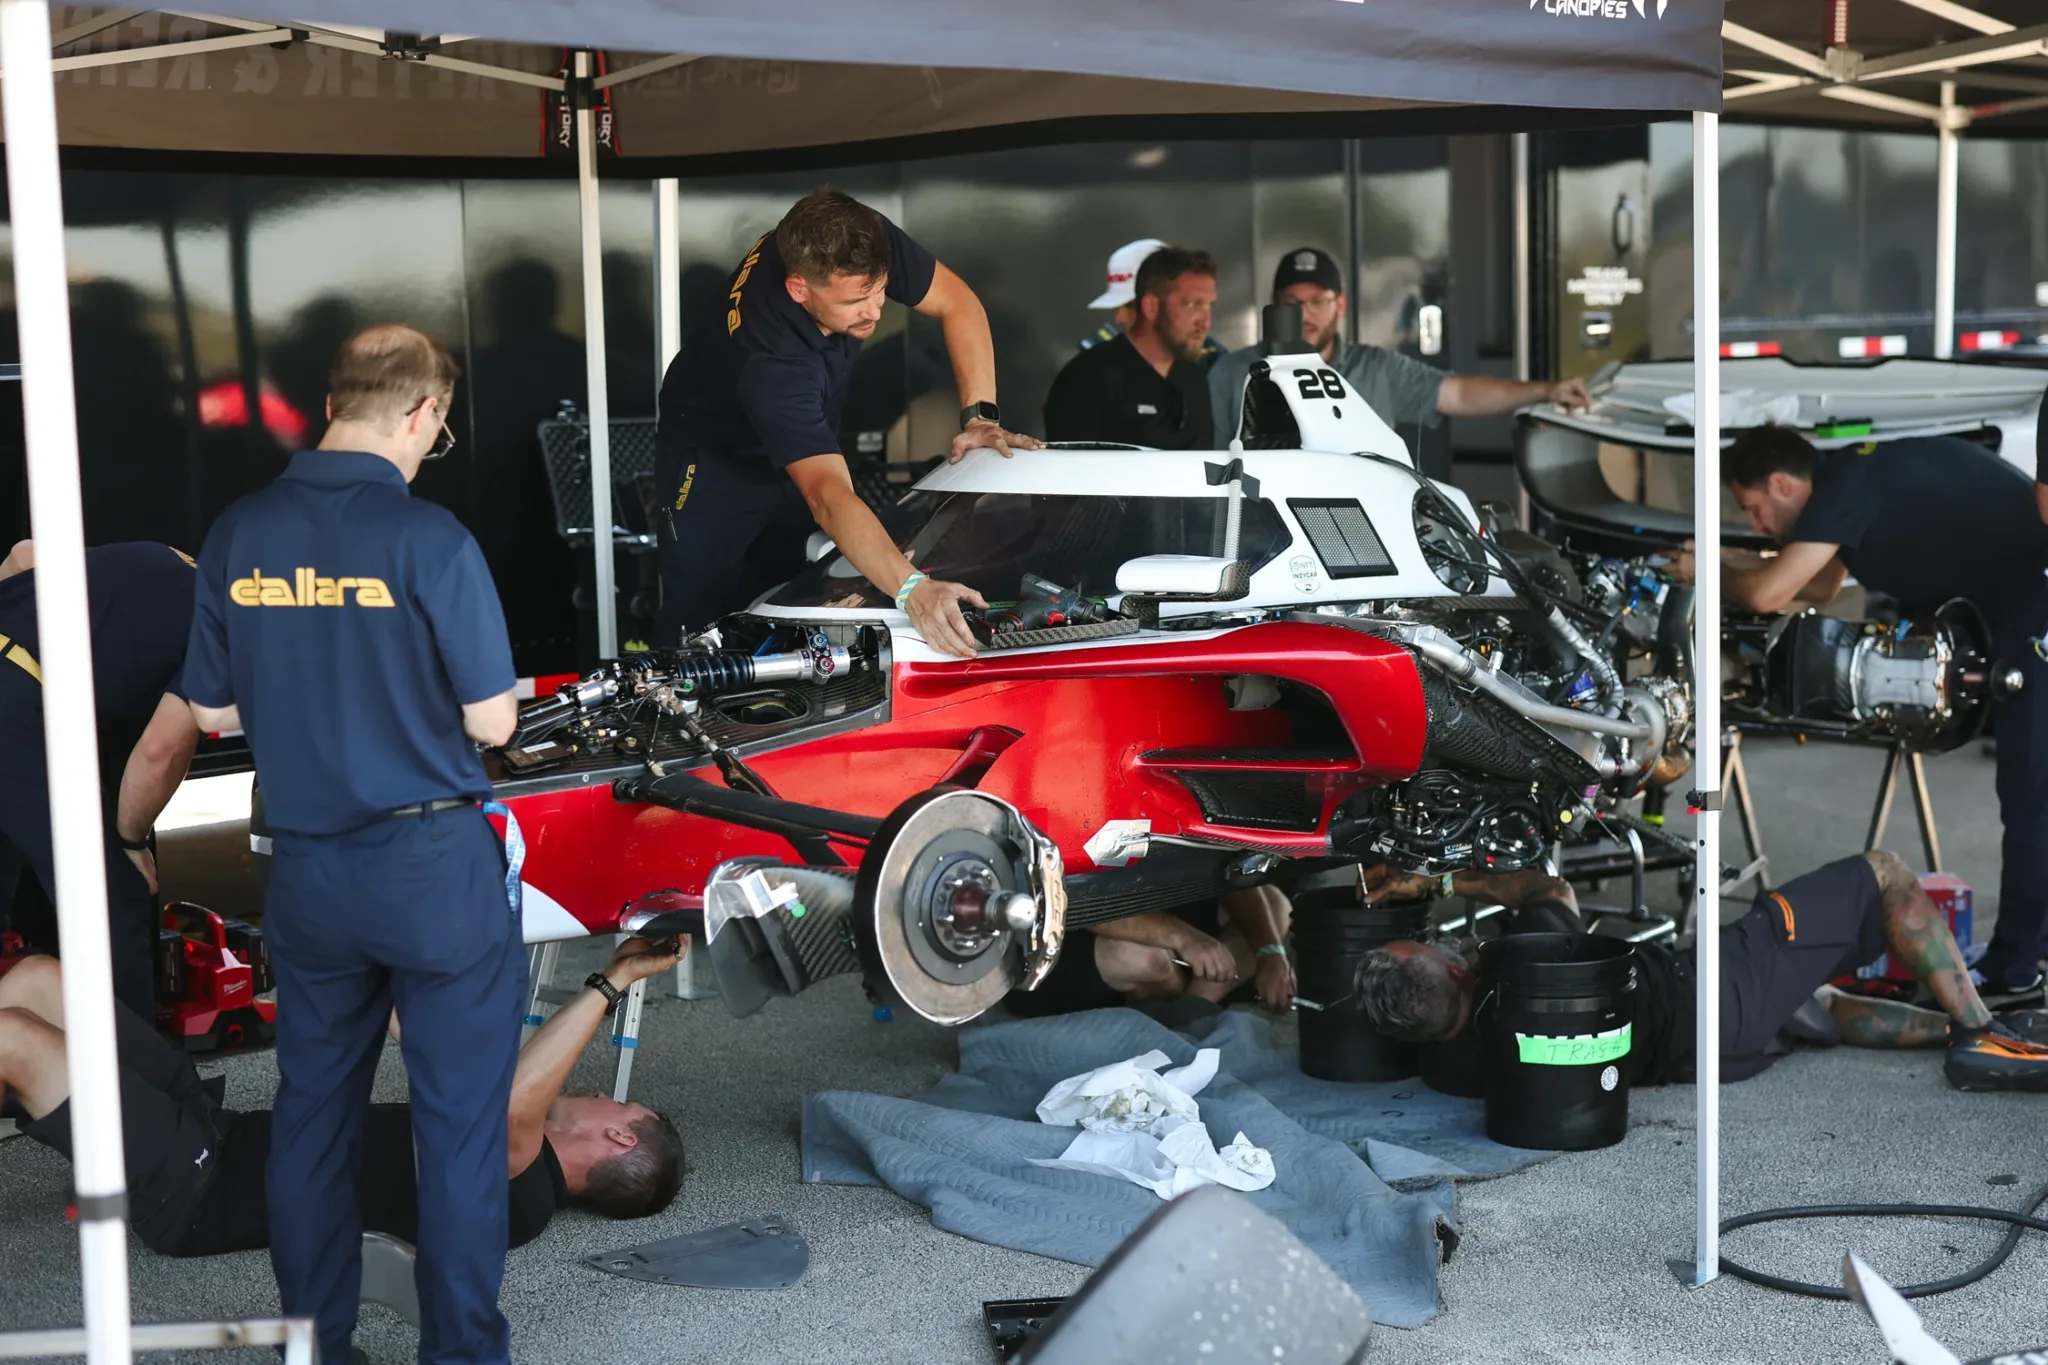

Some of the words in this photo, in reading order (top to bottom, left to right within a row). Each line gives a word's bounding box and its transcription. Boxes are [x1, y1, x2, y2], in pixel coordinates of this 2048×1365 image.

[1544, 0, 1629, 19] CANOPIES
[1292, 368, 1346, 400] 28
[675, 464, 696, 510] dallara
[230, 567, 396, 607] dallara
[1292, 571, 1318, 579] INDYCAR
[1547, 1040, 1624, 1062] TRASH
